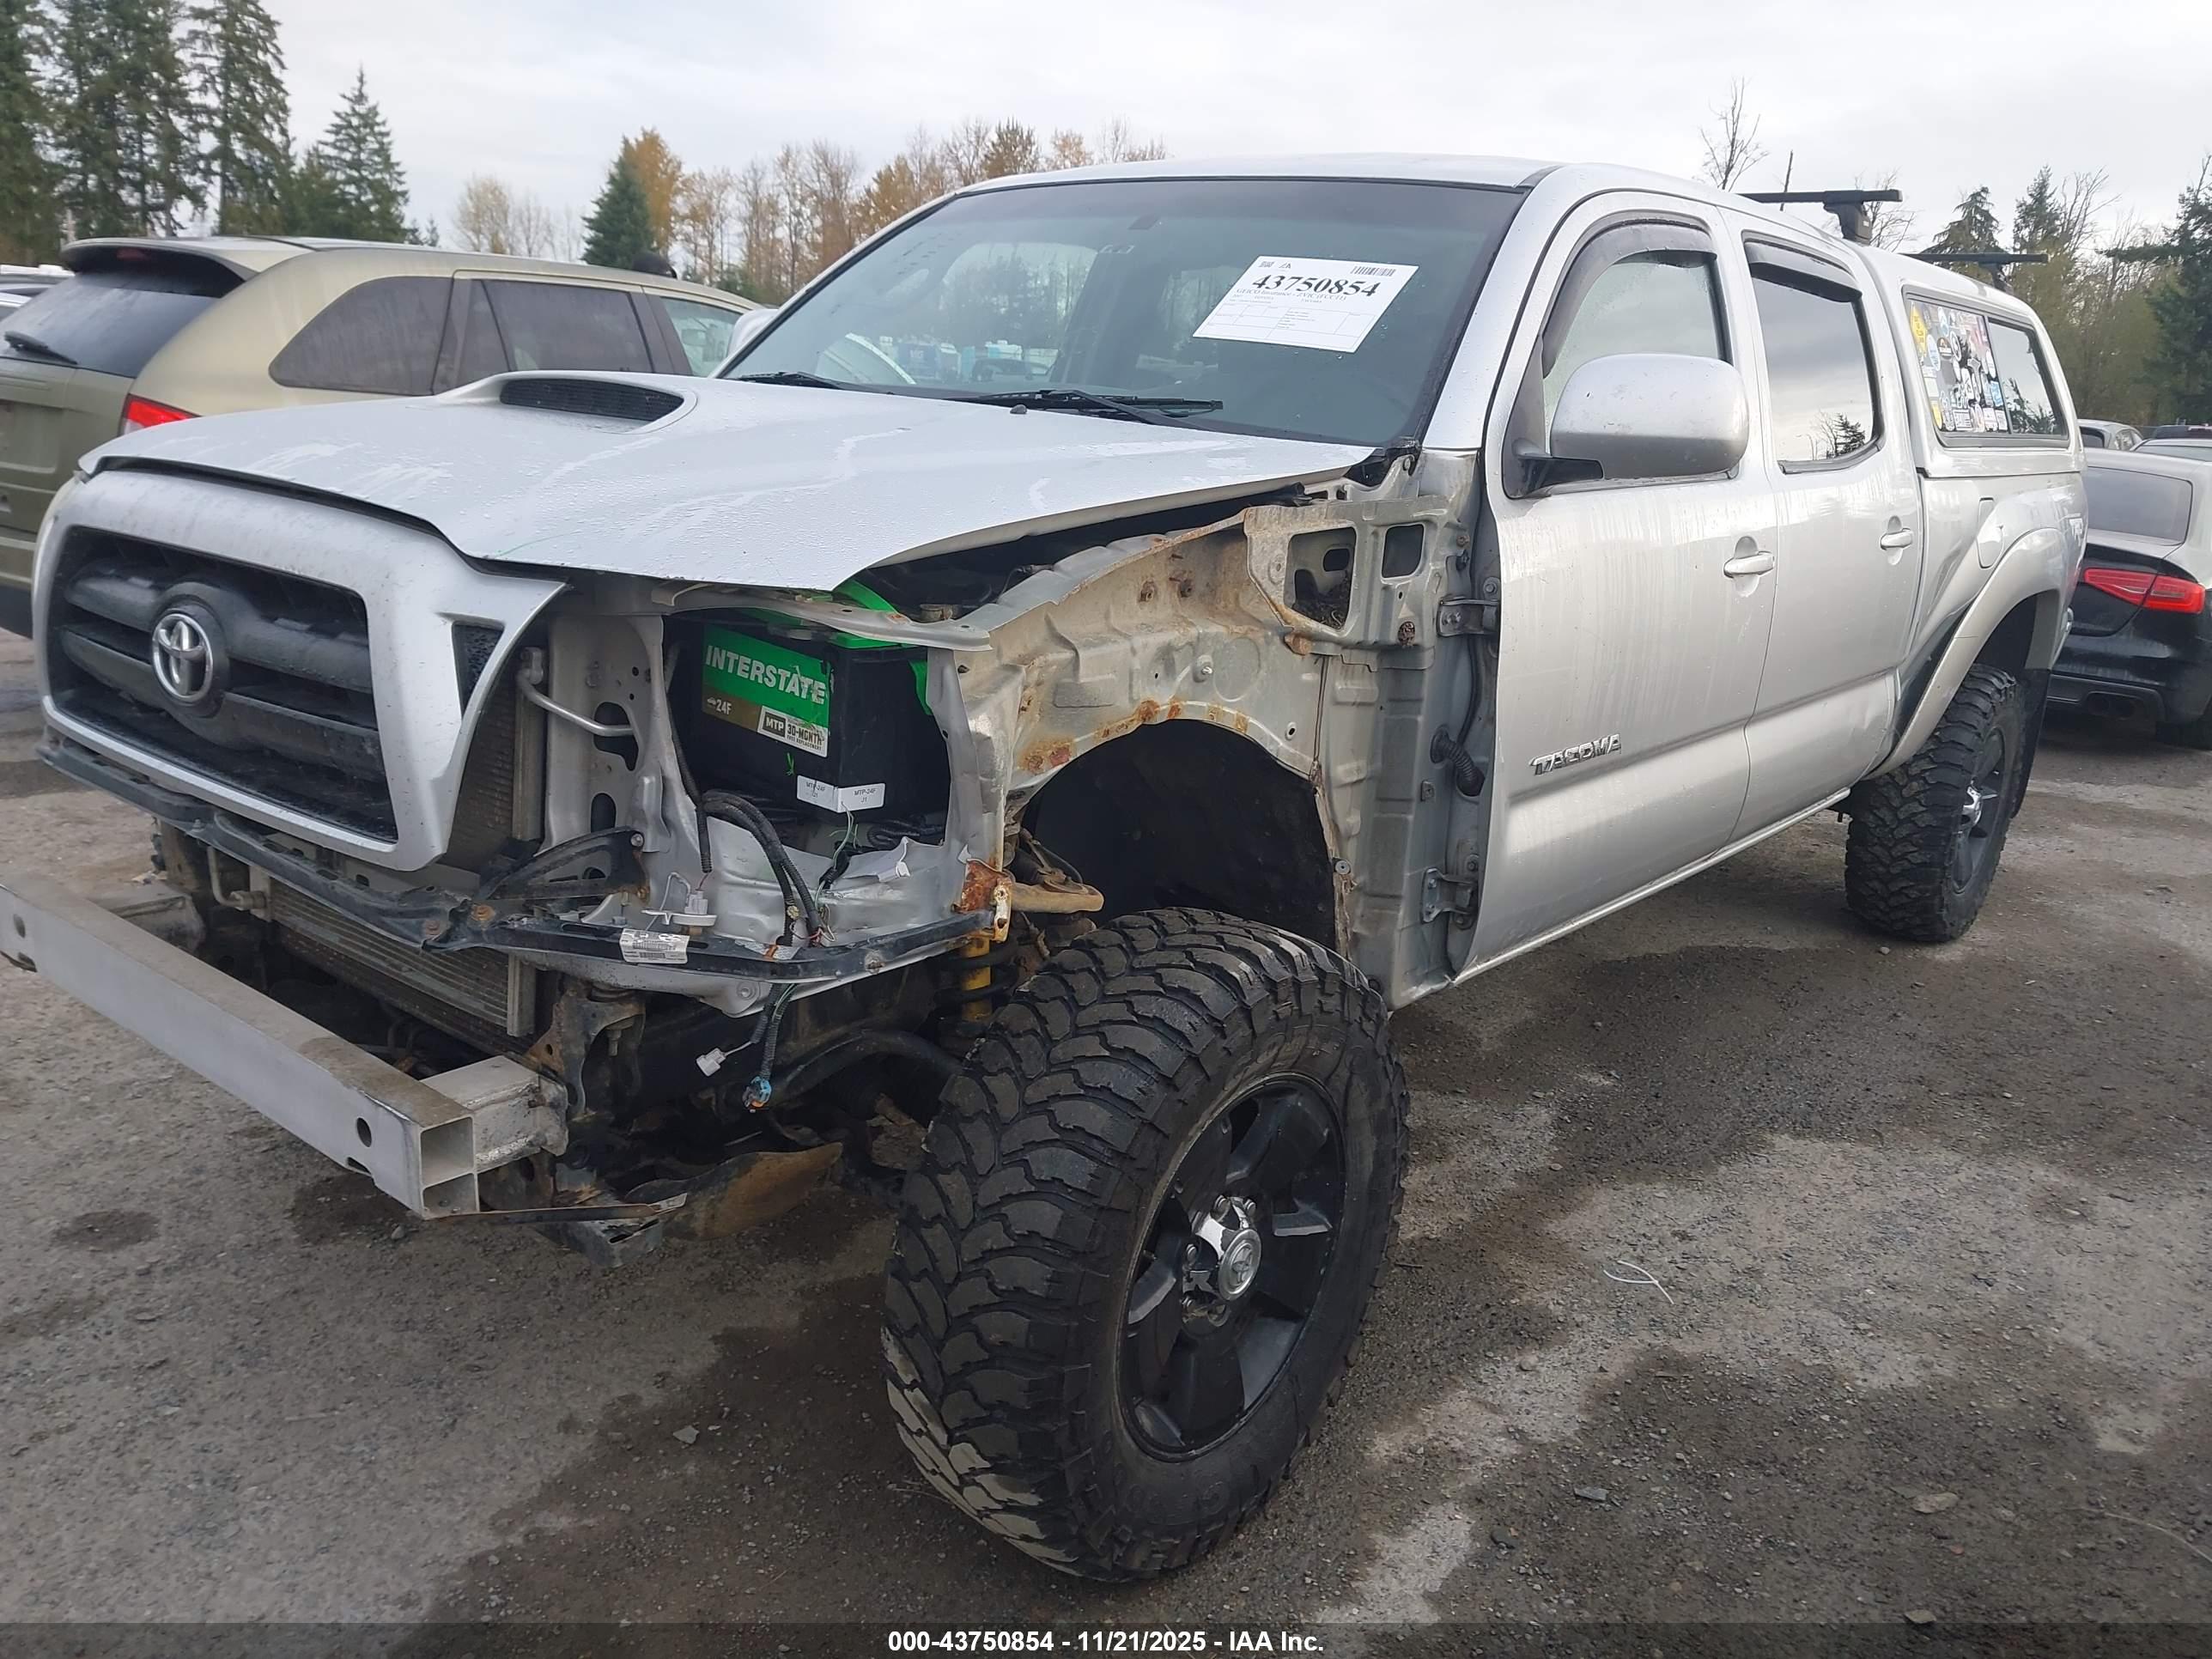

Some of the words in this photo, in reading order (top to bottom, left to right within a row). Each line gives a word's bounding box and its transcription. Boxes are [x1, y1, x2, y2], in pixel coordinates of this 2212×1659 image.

[1252, 275, 1382, 297] 43750854
[705, 645, 826, 705] INTERSTATE
[716, 699, 732, 715] 24F
[765, 716, 785, 732] MTP
[787, 724, 823, 746] 30-MONTH
[1529, 733, 1621, 775] TACOMA
[854, 787, 877, 796] MTP-24F
